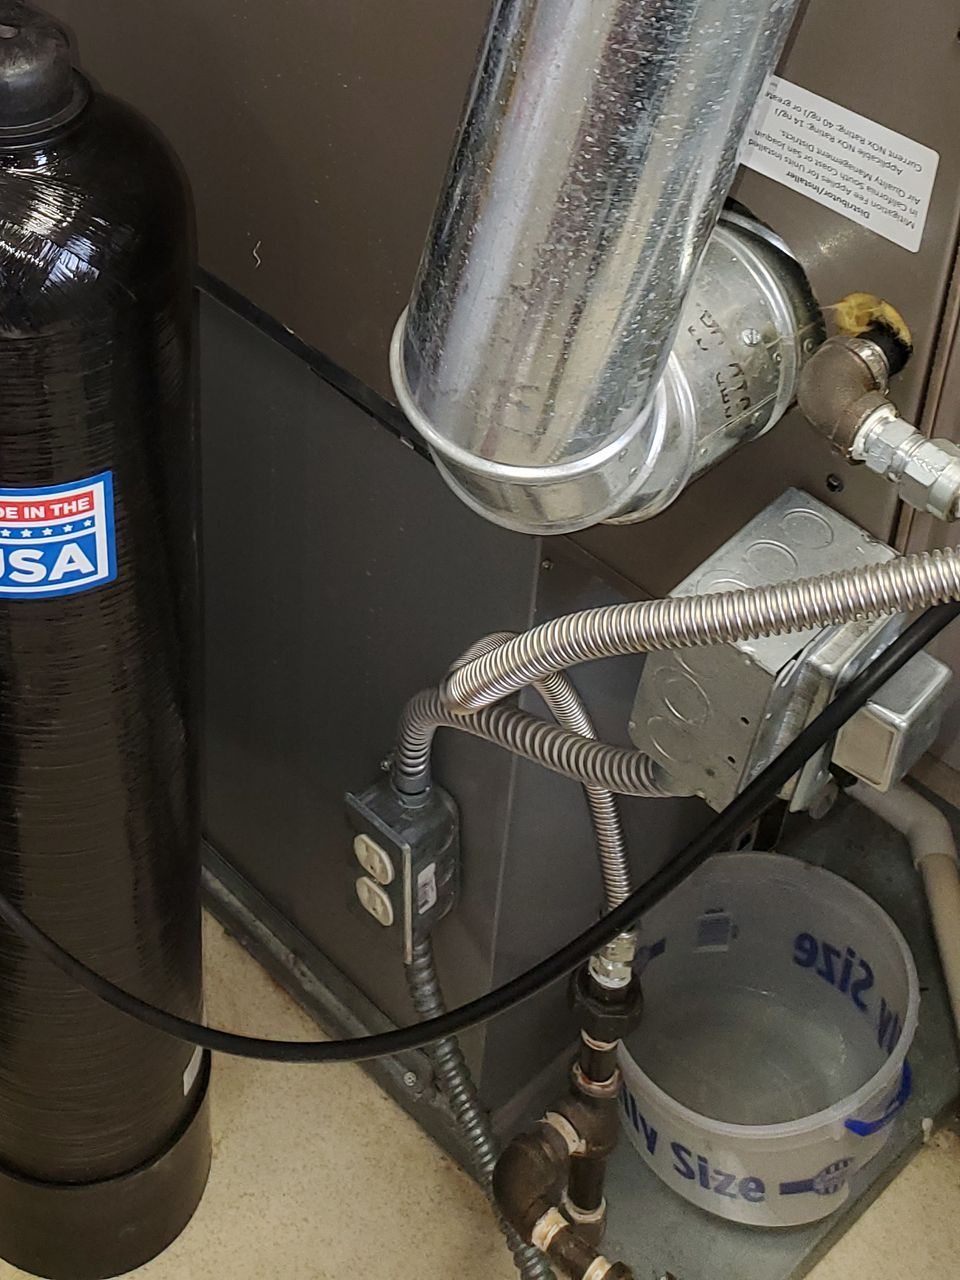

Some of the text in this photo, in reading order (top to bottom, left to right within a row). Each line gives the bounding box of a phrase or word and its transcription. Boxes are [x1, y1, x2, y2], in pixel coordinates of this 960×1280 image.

[24, 506, 45, 519] IN
[50, 497, 90, 517] THE
[670, 1141, 766, 1203] Size
